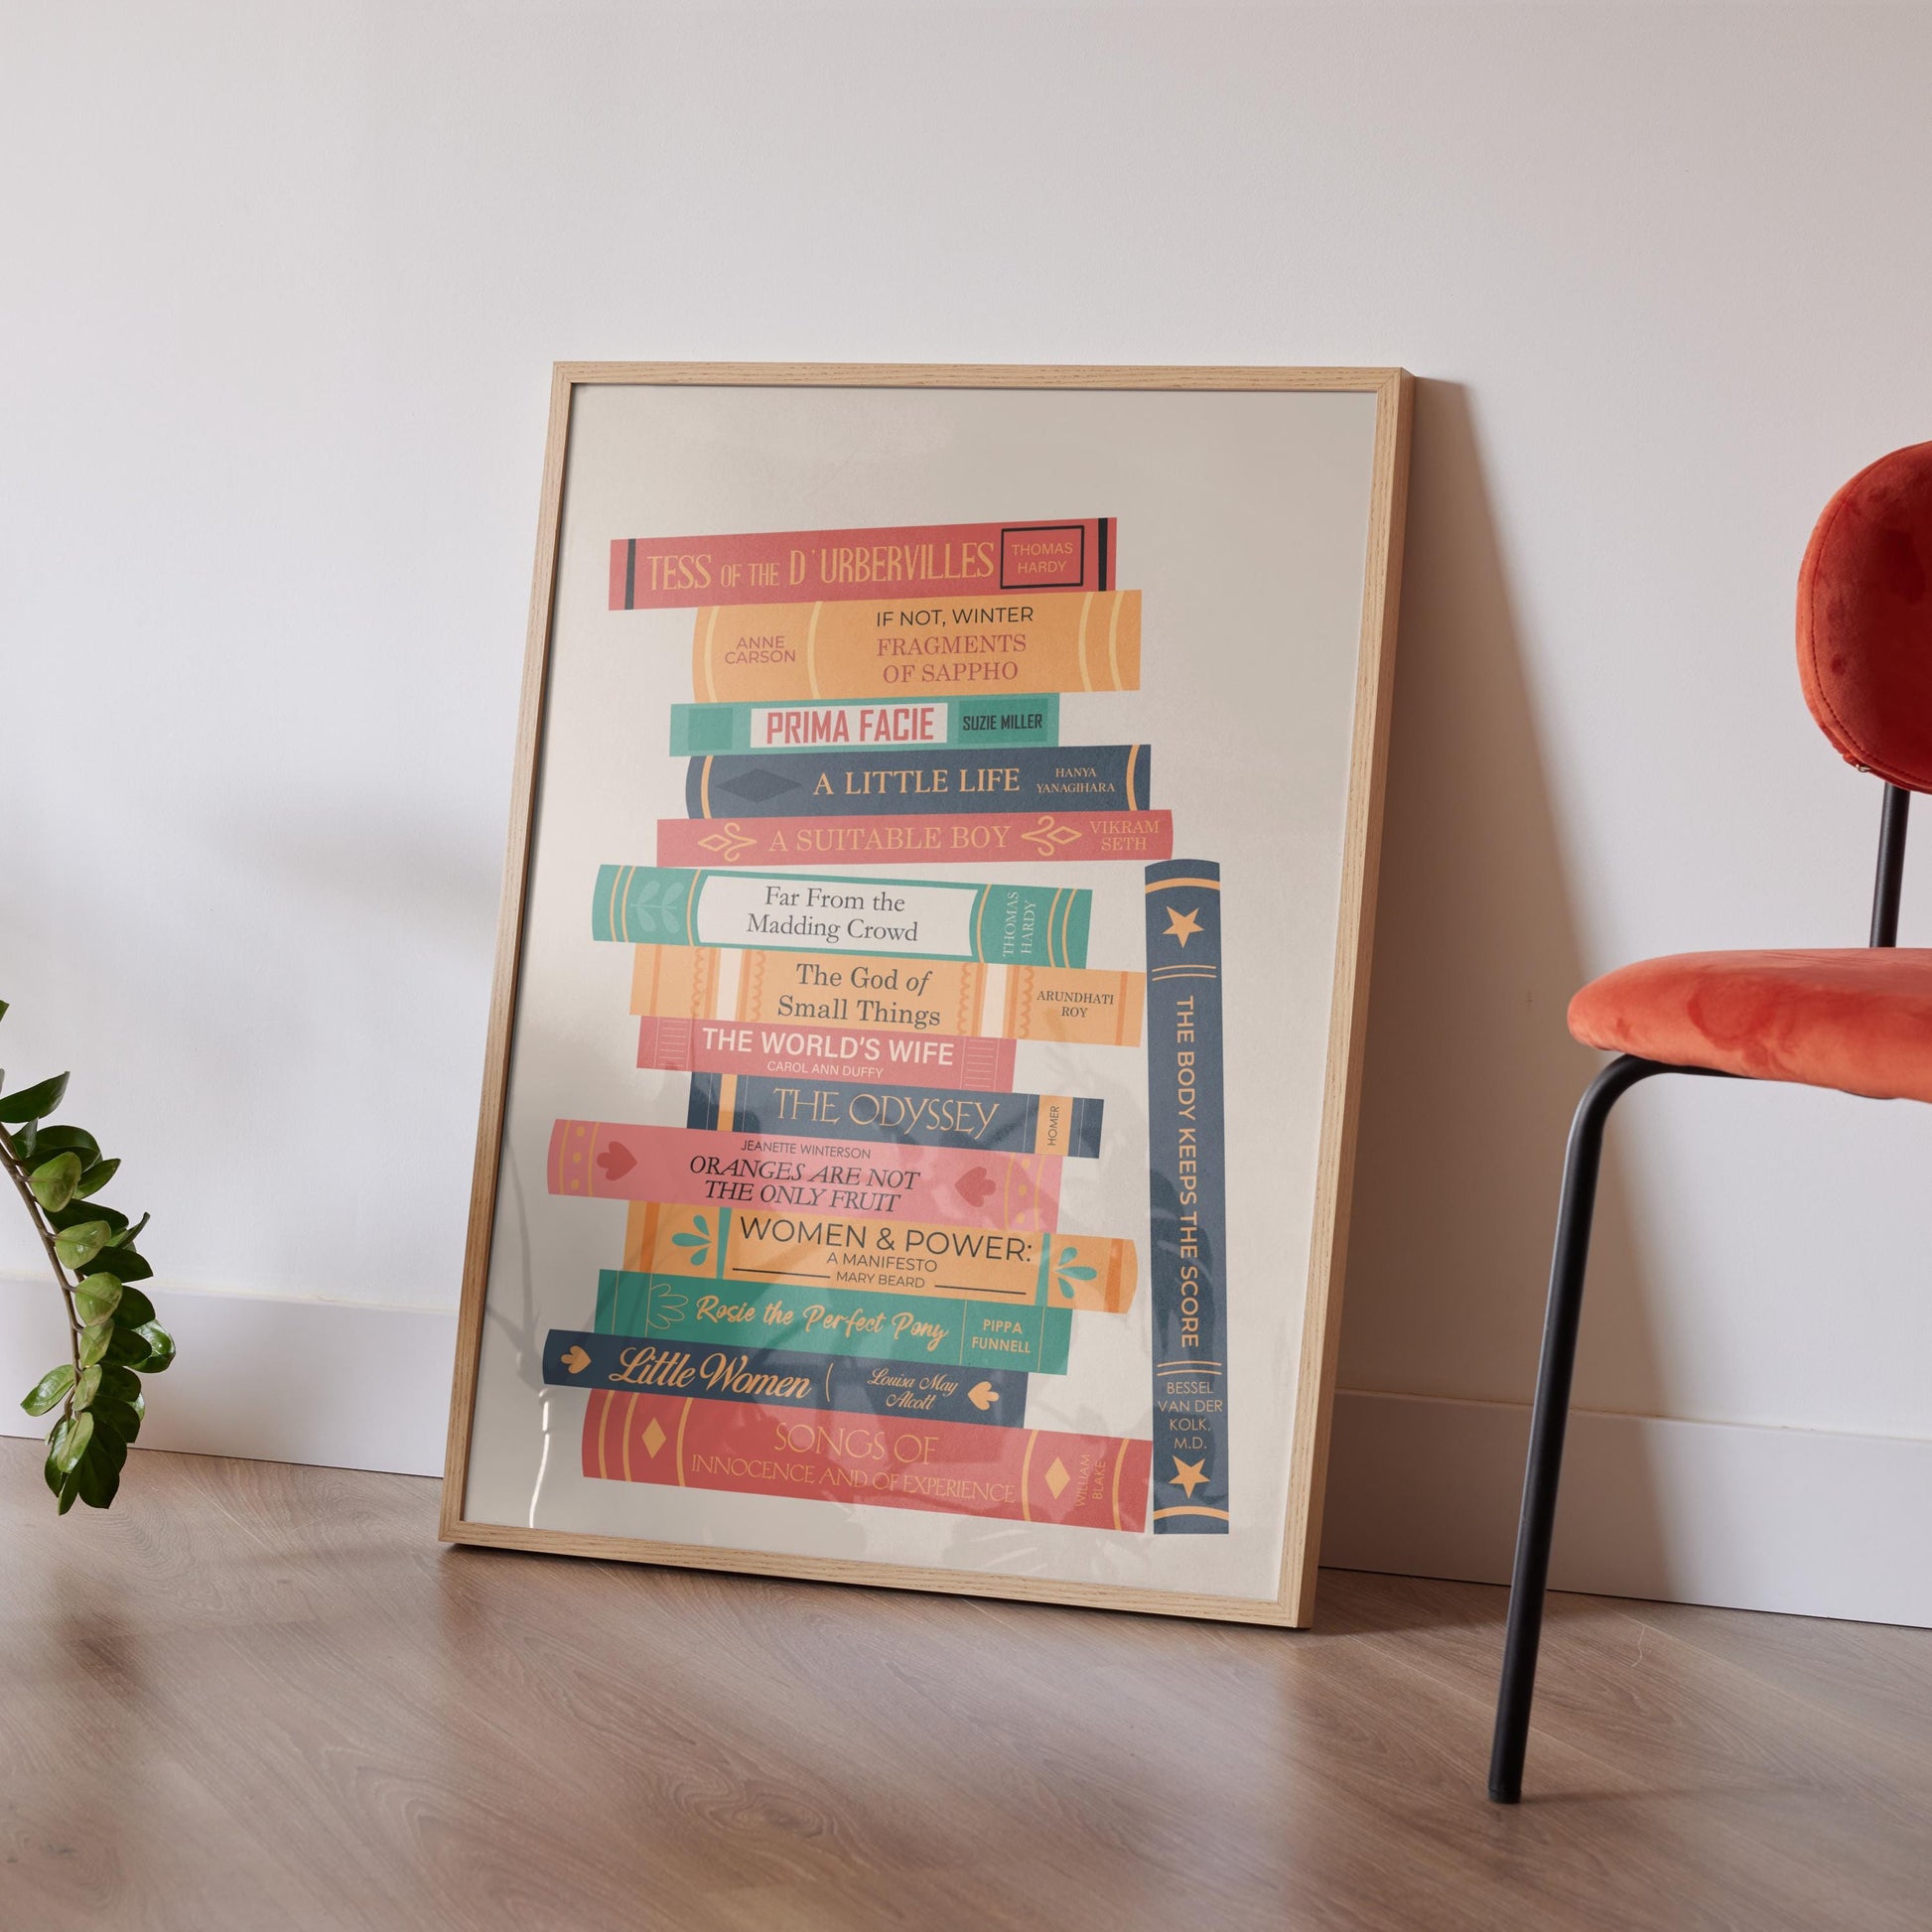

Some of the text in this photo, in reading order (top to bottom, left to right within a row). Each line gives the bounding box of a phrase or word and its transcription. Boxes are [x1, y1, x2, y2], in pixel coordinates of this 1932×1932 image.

[1012, 542, 1073, 557] THOMAS
[647, 554, 712, 592] TESS
[721, 566, 740, 588] OF
[749, 563, 779, 587] THE
[1018, 559, 1066, 574] HARDY
[877, 607, 1034, 627] IF NOT, WINTER
[737, 635, 785, 649] ANNE
[877, 634, 1027, 657] FRAGMENTS
[725, 649, 796, 664] CARSON
[883, 662, 1018, 683] OF SAPPHO
[765, 708, 934, 745] PRIMA FACIE
[963, 714, 1043, 731] SUZIE MILLER
[813, 767, 1021, 795] A LITTLE LIFE
[1055, 767, 1097, 779] HANYA
[1035, 781, 1115, 794] YANAGIHARA
[768, 825, 1012, 852] A SUITABLE BOY
[1090, 820, 1160, 835] VIKRAM
[1101, 836, 1147, 851] SETH
[765, 886, 905, 912] Far From the
[747, 912, 918, 943] Madding Crowd
[1003, 892, 1019, 957] THOMAS
[1021, 899, 1035, 954] HARDY
[795, 964, 932, 995] The God of
[1036, 990, 1114, 1005] ARUNDHATI
[776, 995, 940, 1031] Small Things
[1061, 1006, 1088, 1018] ROY
[702, 1027, 954, 1065] THE WORLD'S WIFE
[767, 1061, 884, 1078] CAROL ANN DUFFY
[773, 1087, 1000, 1139] THE ODYSSEY
[1047, 1106, 1060, 1146] HOMER
[741, 1140, 871, 1160] JEANETTE WINTERSON
[689, 1155, 920, 1191] ORANGES ARE NOT
[1176, 996, 1199, 1346] THE BODY KEEPS THE SCORE
[705, 1180, 900, 1212] THE ONLY FRUIT
[740, 1216, 1032, 1262] WOMEN & POWER:
[826, 1253, 937, 1273] A MANIFESTO
[836, 1271, 924, 1289] MARY BEARD
[696, 1295, 949, 1352] Rosie the Perfect Pony
[983, 1318, 1023, 1334] PIPPA
[971, 1336, 1031, 1353] FUNNELL
[610, 1346, 810, 1399] Little Women
[868, 1368, 957, 1397] Louisa May
[1167, 1381, 1213, 1395] BESSEL
[886, 1392, 935, 1410] Alcott
[1158, 1399, 1223, 1413] VAN DER
[1170, 1418, 1211, 1432] KOLK,
[774, 1422, 939, 1465] SONGS OF
[1173, 1437, 1207, 1449] M.D.
[691, 1454, 1017, 1504] INNOCENCE AND OF EXPERIENCE
[1074, 1453, 1090, 1507] WILLIAM
[1092, 1459, 1106, 1500] BLAKE
